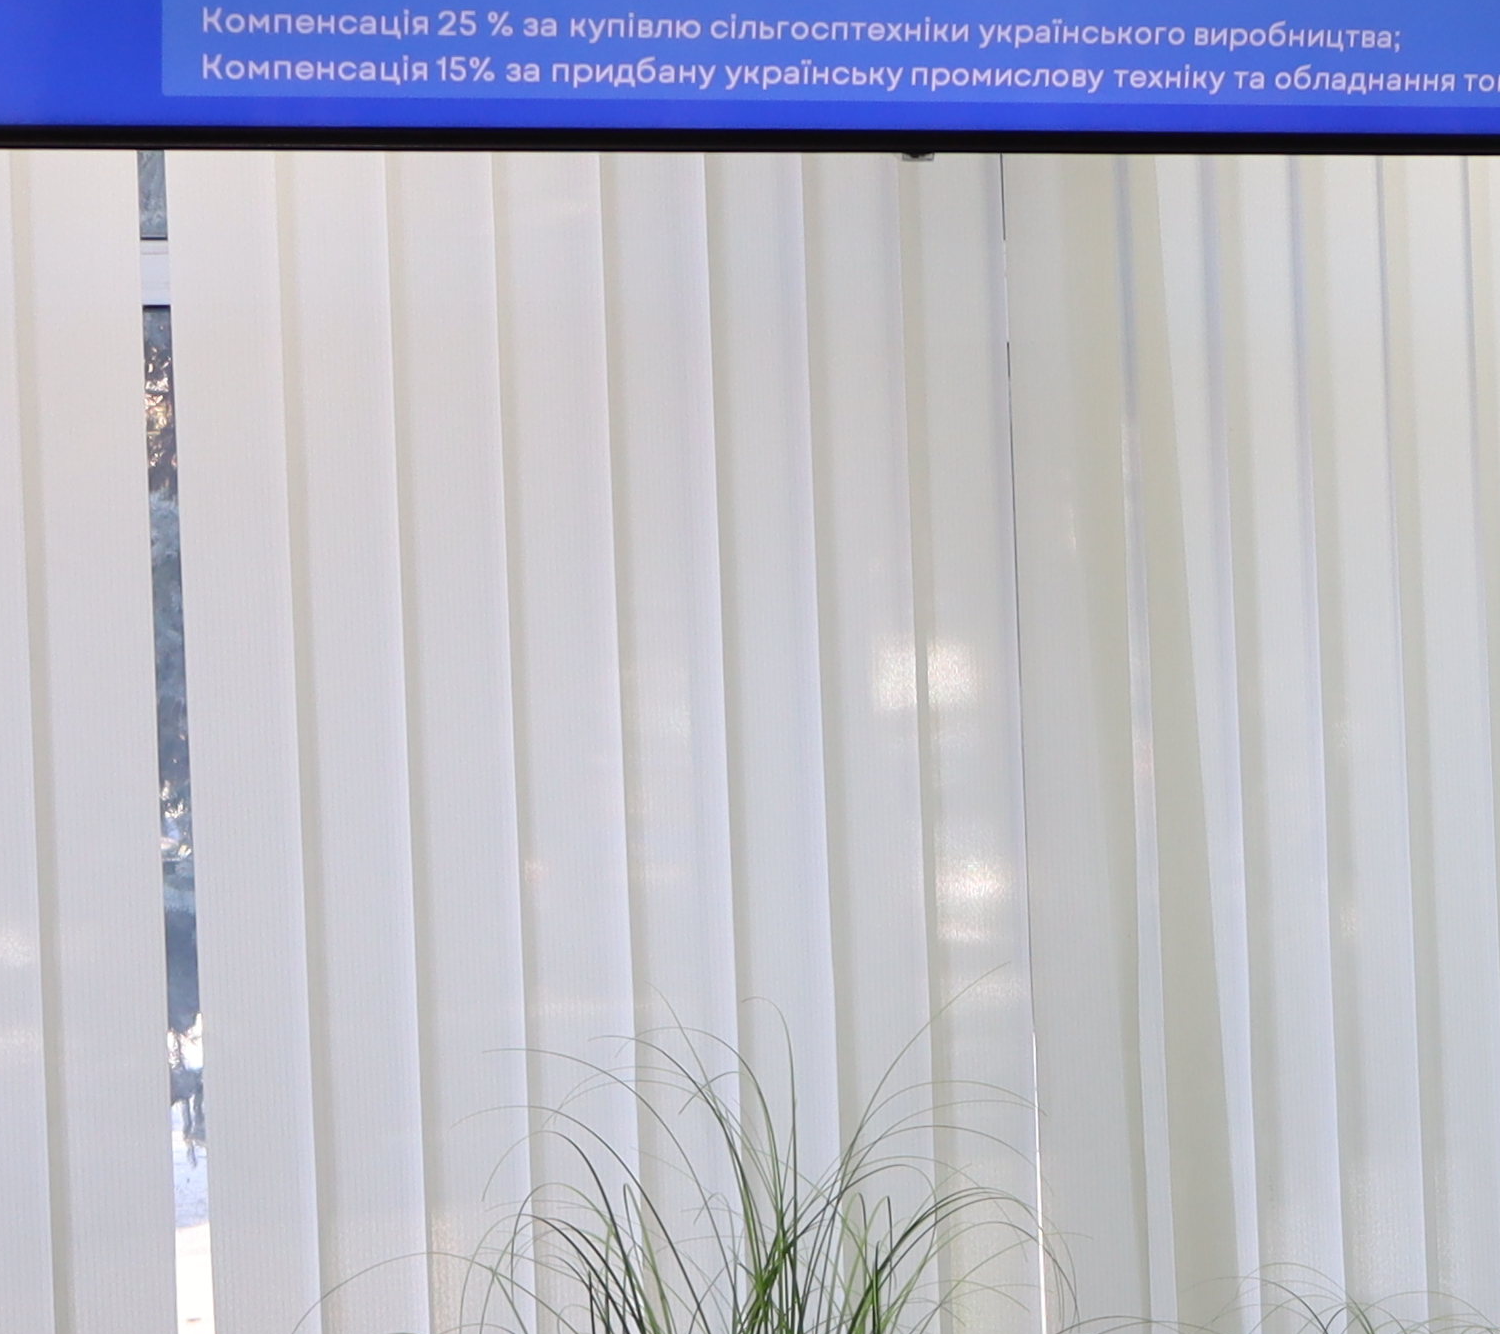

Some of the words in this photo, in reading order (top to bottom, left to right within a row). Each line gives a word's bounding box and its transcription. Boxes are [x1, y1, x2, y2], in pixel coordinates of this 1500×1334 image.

[203, 7, 428, 39] Компенсація
[438, 10, 476, 36] 25
[523, 17, 557, 37] за
[571, 12, 701, 43] купівлю
[711, 14, 969, 42] сільгосптехніки
[979, 19, 1185, 48] українського
[1194, 21, 1400, 52] виробництва;
[203, 54, 428, 85] Компенсація
[437, 56, 495, 81] 15%
[506, 63, 540, 82] за
[552, 57, 716, 89] придбану
[725, 59, 903, 91] українську
[912, 67, 1104, 93] промислову
[1114, 64, 1225, 94] техніку
[1234, 71, 1264, 89] та
[1275, 64, 1455, 94] обладнання
